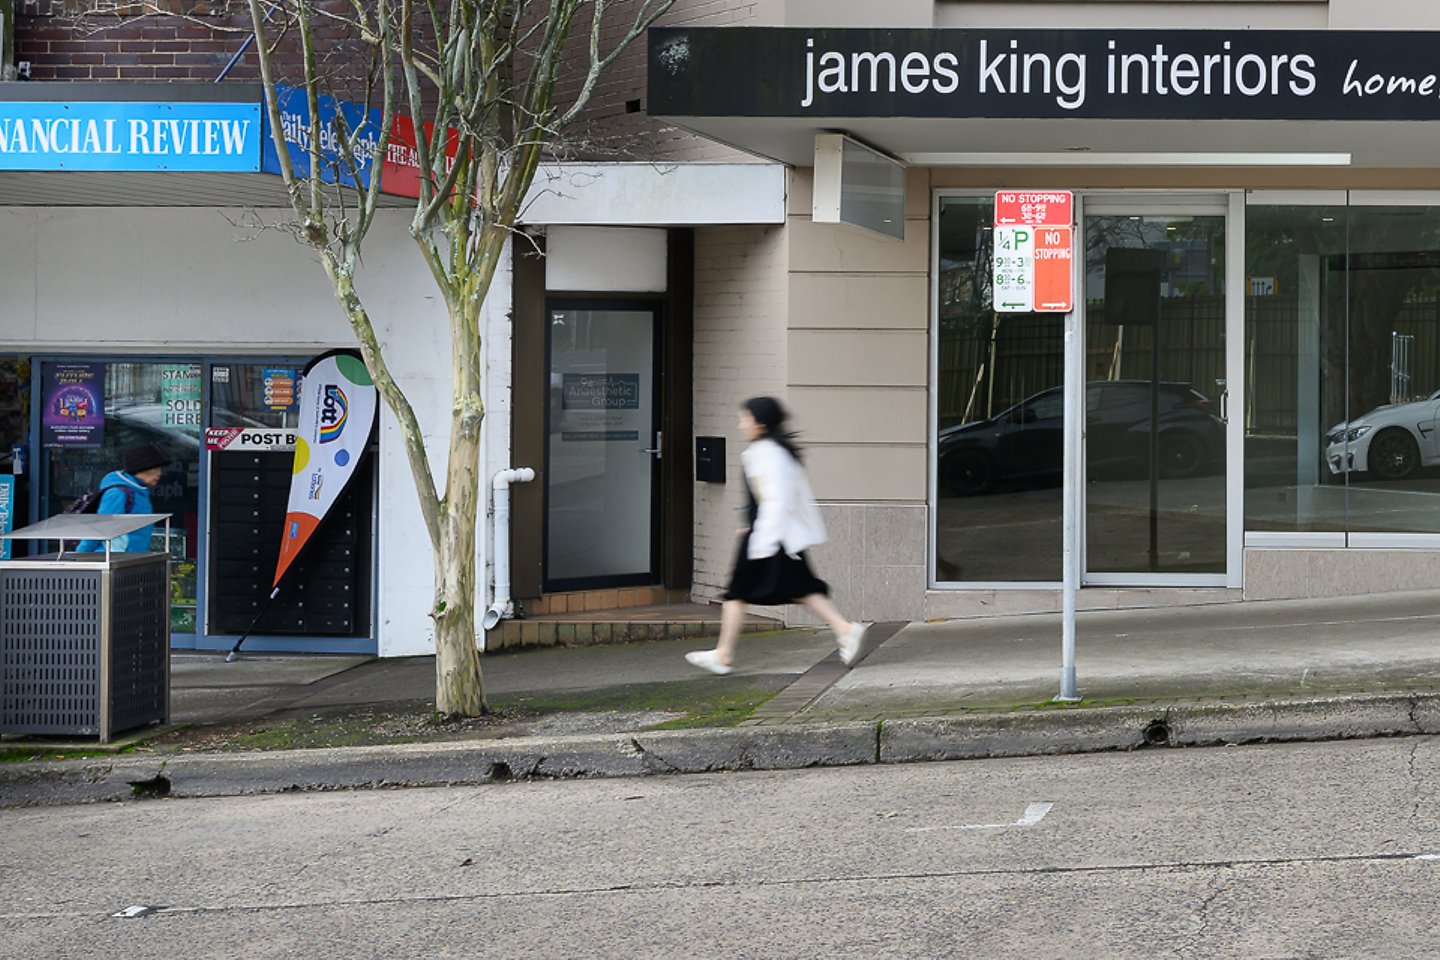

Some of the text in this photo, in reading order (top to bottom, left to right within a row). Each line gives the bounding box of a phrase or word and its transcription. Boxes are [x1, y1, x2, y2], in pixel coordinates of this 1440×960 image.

[801, 38, 1317, 109] james king interiors
[127, 119, 250, 155] REVIEW
[387, 143, 407, 165] THE
[1002, 194, 1066, 203] NO STOPPING
[1045, 232, 1060, 245] NO
[1035, 248, 1071, 259] STOPPING
[165, 400, 201, 411] SOLD
[592, 397, 626, 409] Group
[241, 433, 282, 445] POST
